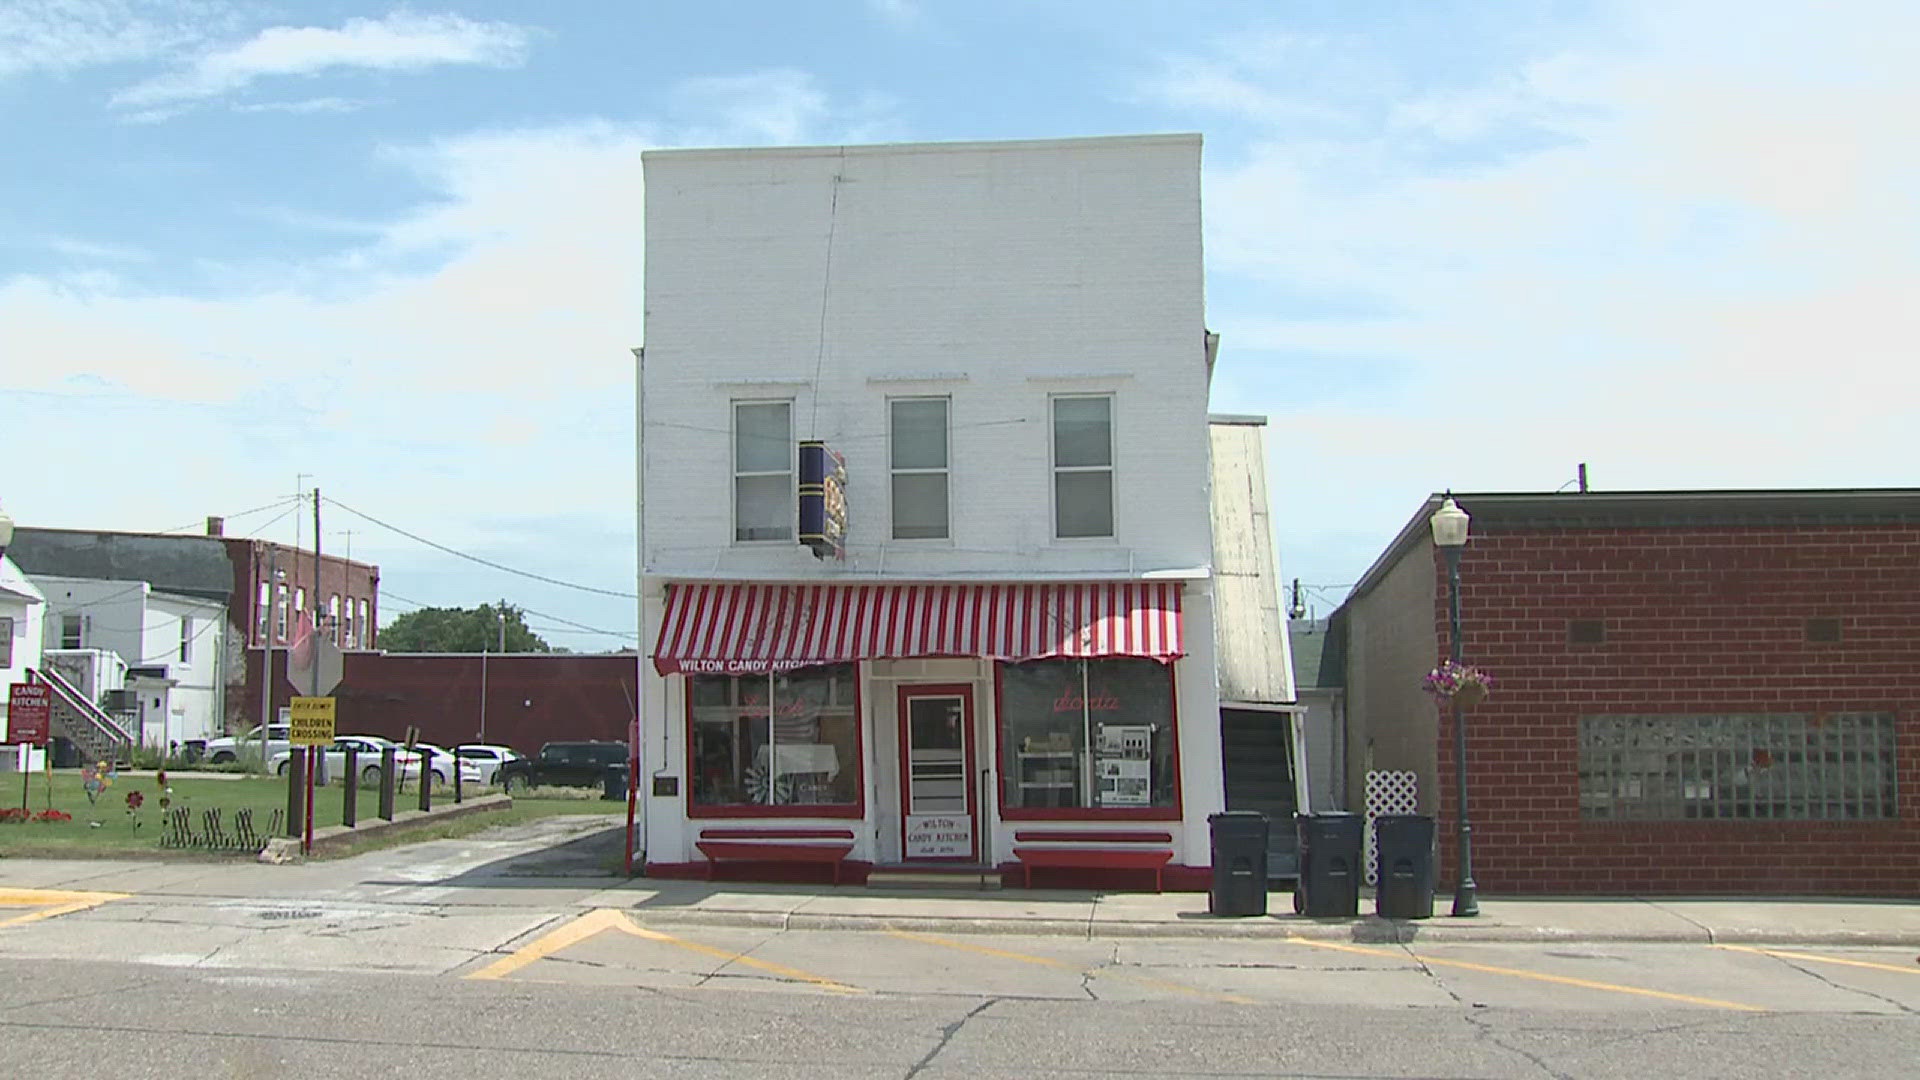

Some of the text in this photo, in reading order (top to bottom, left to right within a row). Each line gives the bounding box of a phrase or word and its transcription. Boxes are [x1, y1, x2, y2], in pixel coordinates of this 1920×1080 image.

[679, 659, 724, 671] WILTON
[728, 659, 768, 671] CANDY
[15, 687, 44, 696] CANDY
[12, 697, 48, 707] KITCHEN
[291, 718, 332, 728] CHILDREN
[291, 729, 332, 739] CROSSING
[922, 818, 955, 829] WILTON
[908, 832, 969, 843] CANDY KITCHEN
